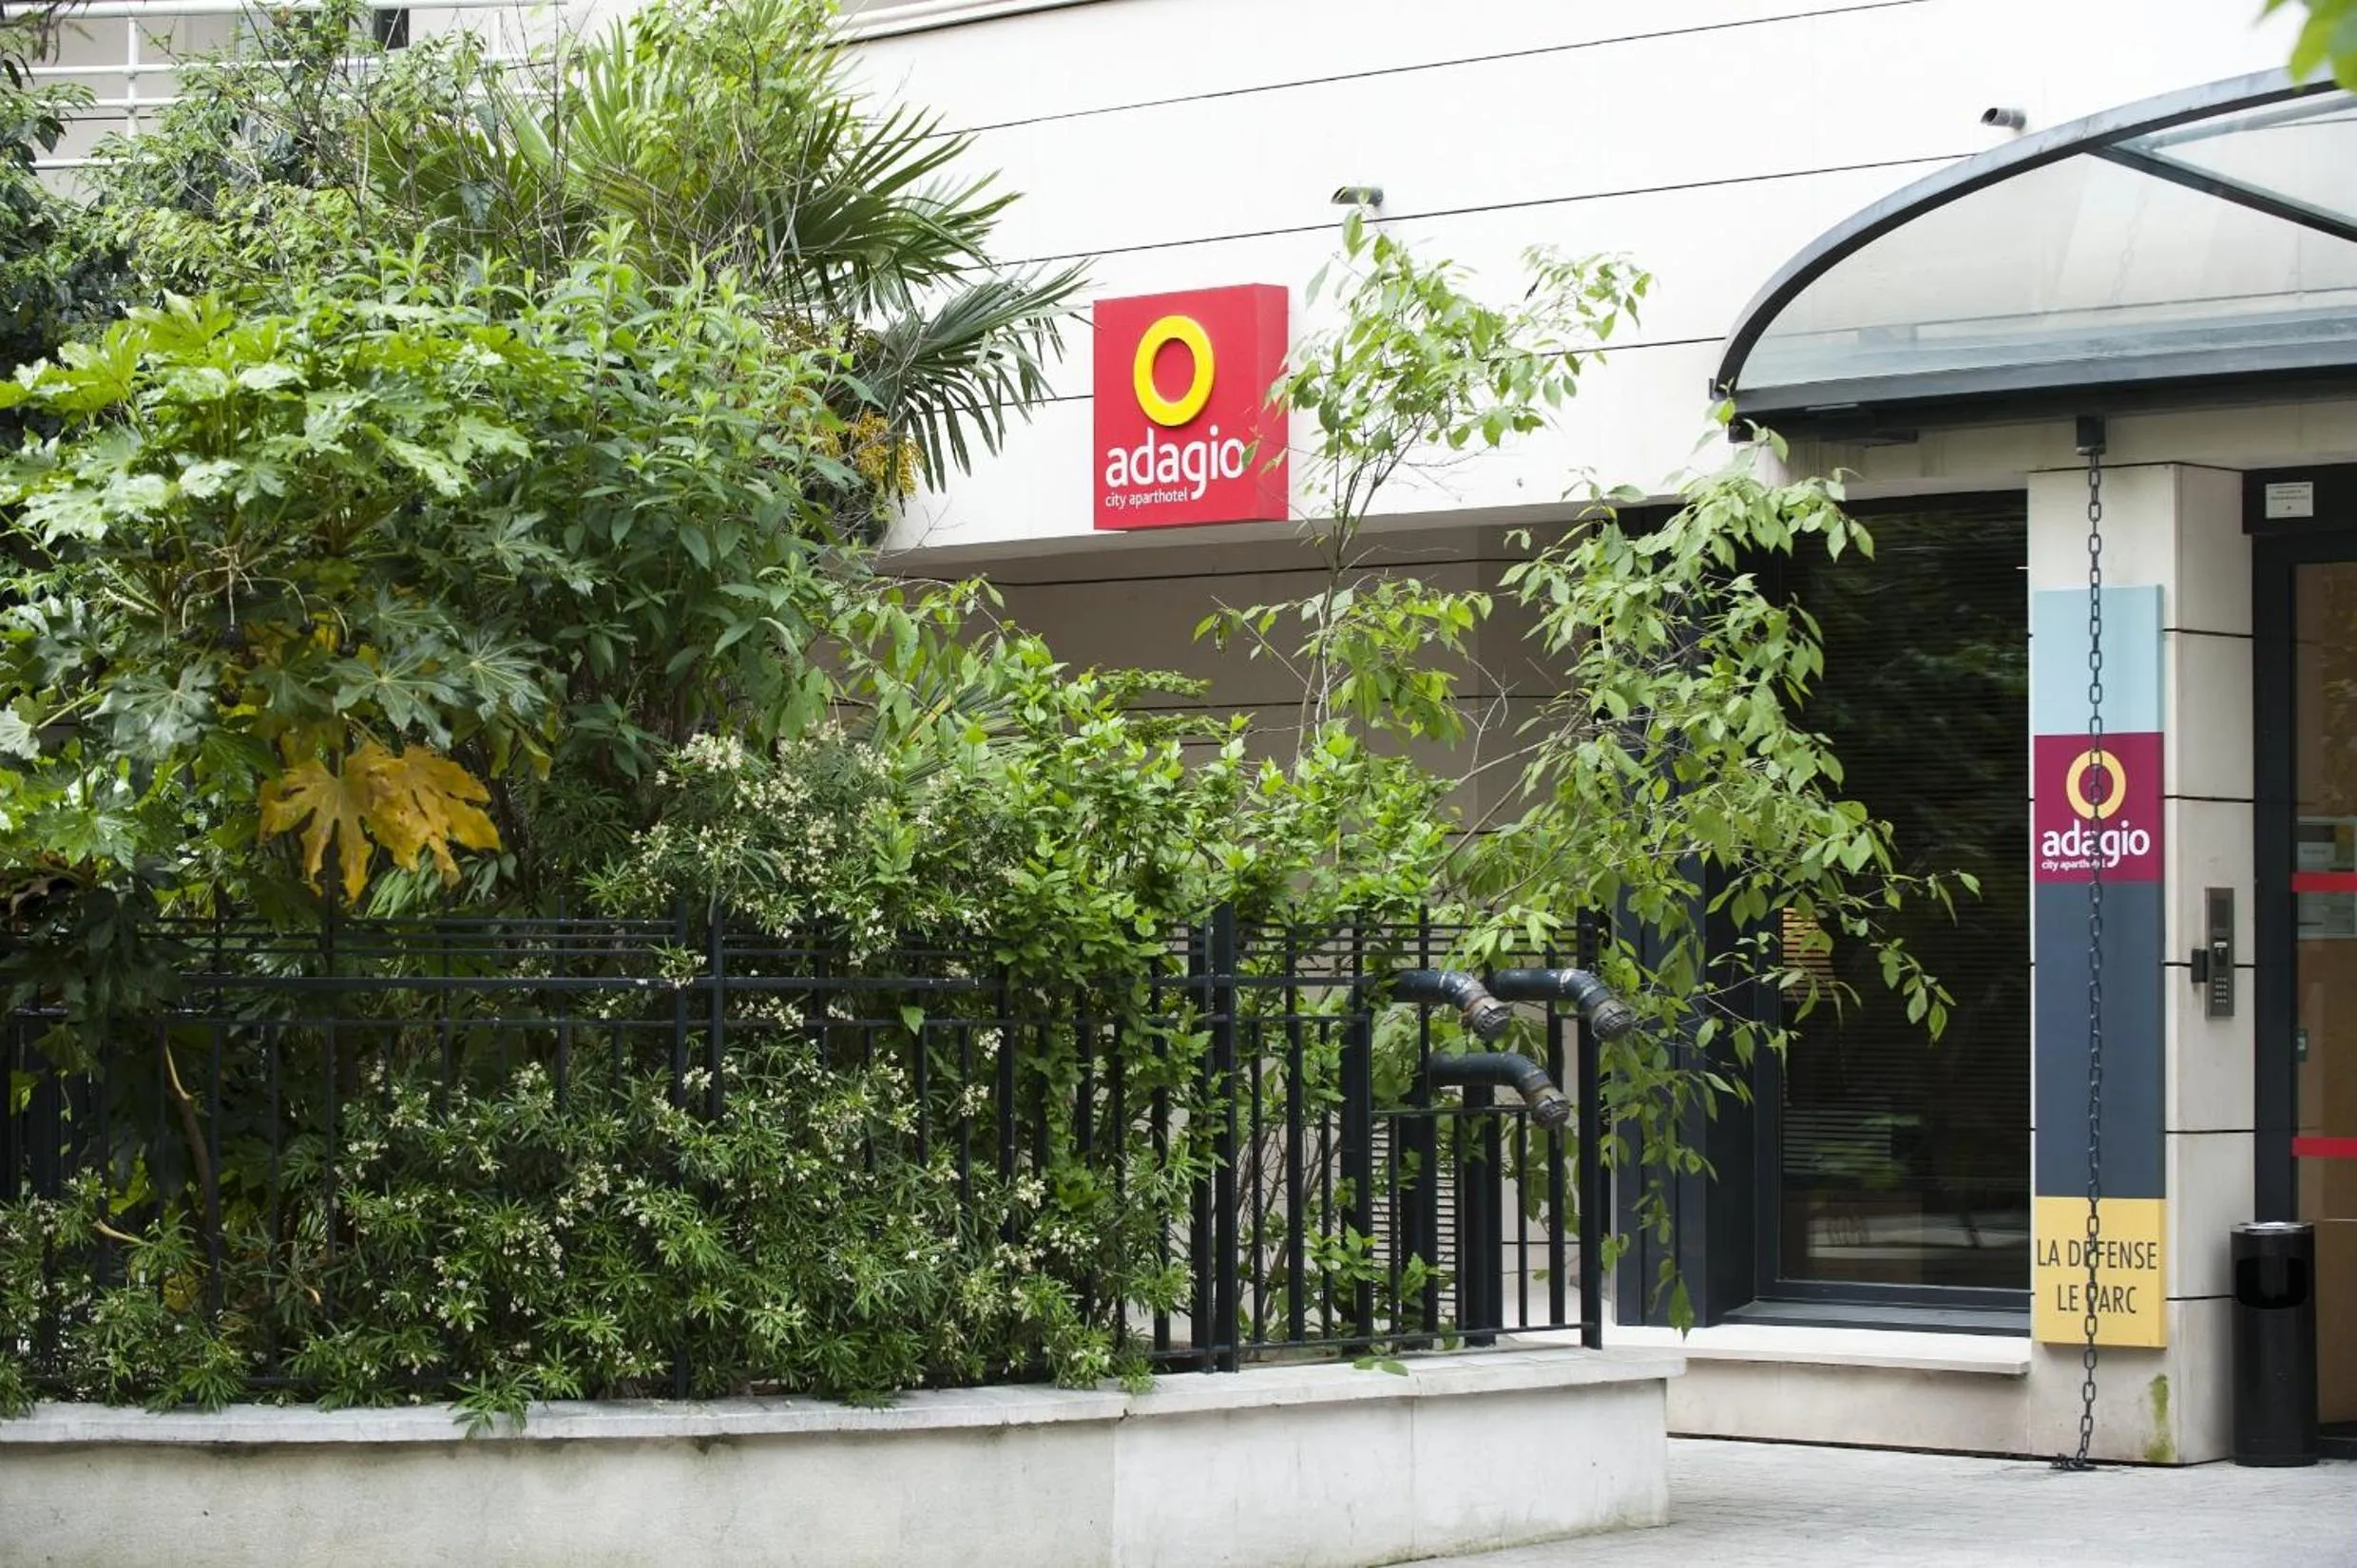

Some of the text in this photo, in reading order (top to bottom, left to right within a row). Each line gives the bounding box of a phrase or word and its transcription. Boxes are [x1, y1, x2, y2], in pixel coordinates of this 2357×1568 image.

[1105, 426, 1245, 500] adagio
[1105, 487, 1187, 509] city aparthotel
[2041, 818, 2150, 868] adagio
[2041, 859, 2059, 871] city
[2037, 1239, 2060, 1267] LA
[2058, 1285, 2137, 1313] LE ARC
